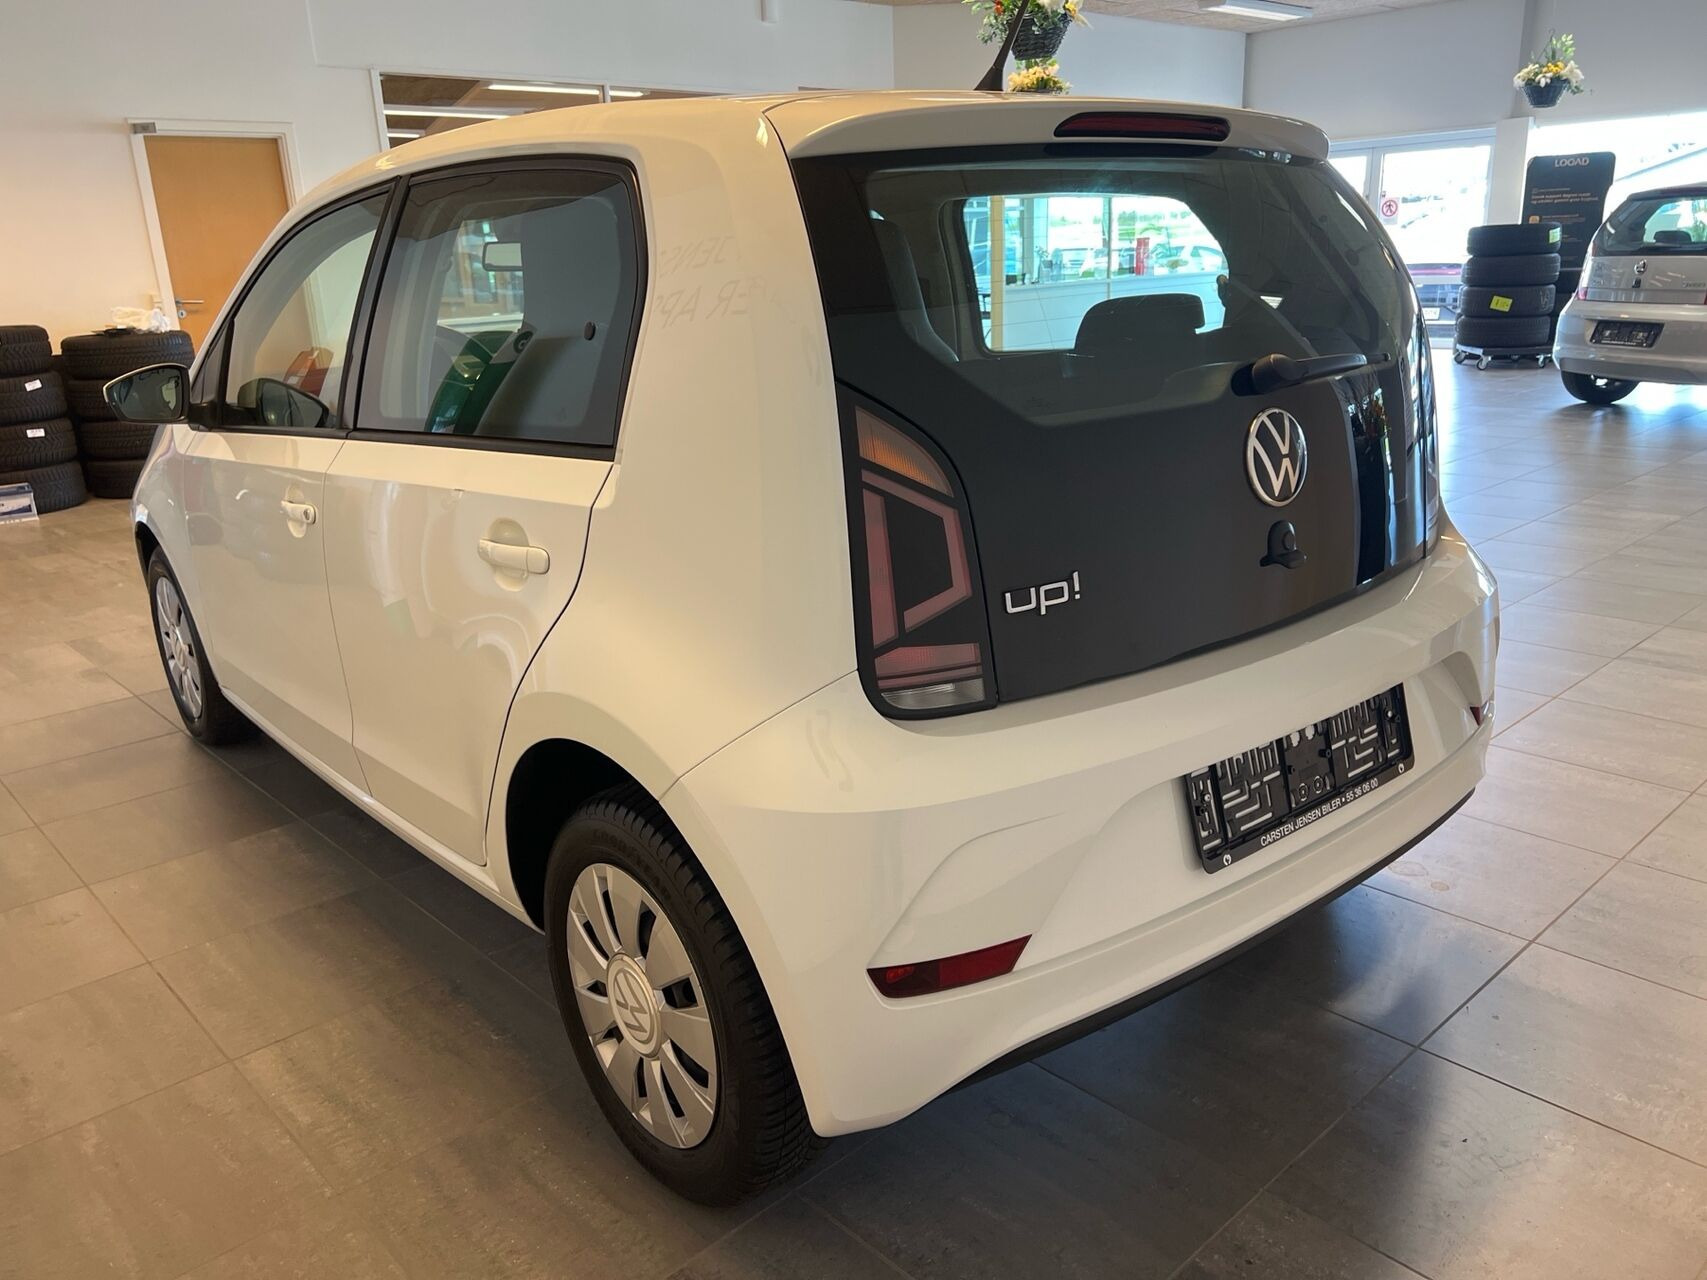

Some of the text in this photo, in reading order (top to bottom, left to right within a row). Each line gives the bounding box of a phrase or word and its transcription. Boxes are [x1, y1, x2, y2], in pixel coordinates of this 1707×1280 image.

[1005, 570, 1081, 616] up!
[1260, 823, 1294, 846] CARSTEN
[1295, 808, 1321, 829] JENSEN
[1322, 798, 1341, 815] BILER
[1346, 790, 1354, 802] 55
[1362, 782, 1370, 793] 06
[1370, 777, 1379, 789] 00
